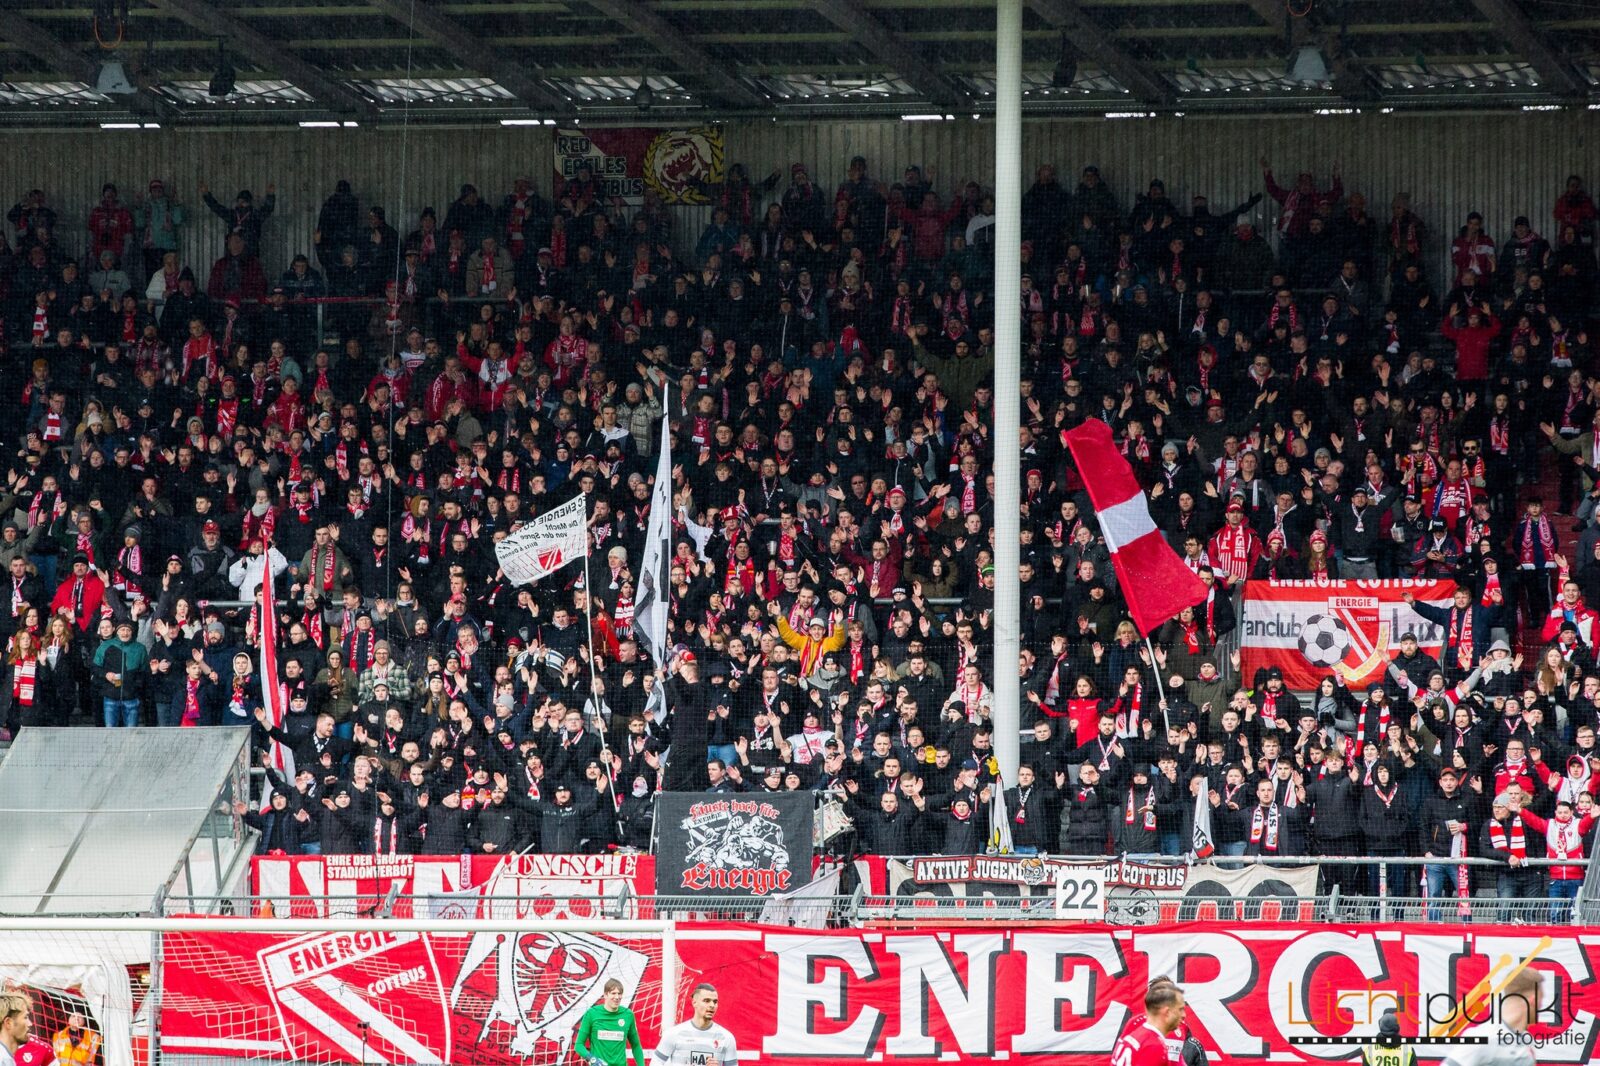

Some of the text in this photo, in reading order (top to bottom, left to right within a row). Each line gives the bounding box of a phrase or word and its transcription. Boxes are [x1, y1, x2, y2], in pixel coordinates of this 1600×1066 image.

[556, 136, 592, 155] RED
[1335, 598, 1372, 607] ENERGIE
[326, 854, 352, 866] EHRE
[353, 854, 373, 865] DER
[327, 864, 414, 879] STADIONVERBOT
[681, 861, 792, 896] Energie
[1122, 862, 1184, 887] COTTBUS
[1062, 878, 1098, 910] 22
[287, 931, 398, 976] ENERGIE
[366, 965, 428, 997] COTTBUS
[761, 929, 1600, 1060] ENERGIE
